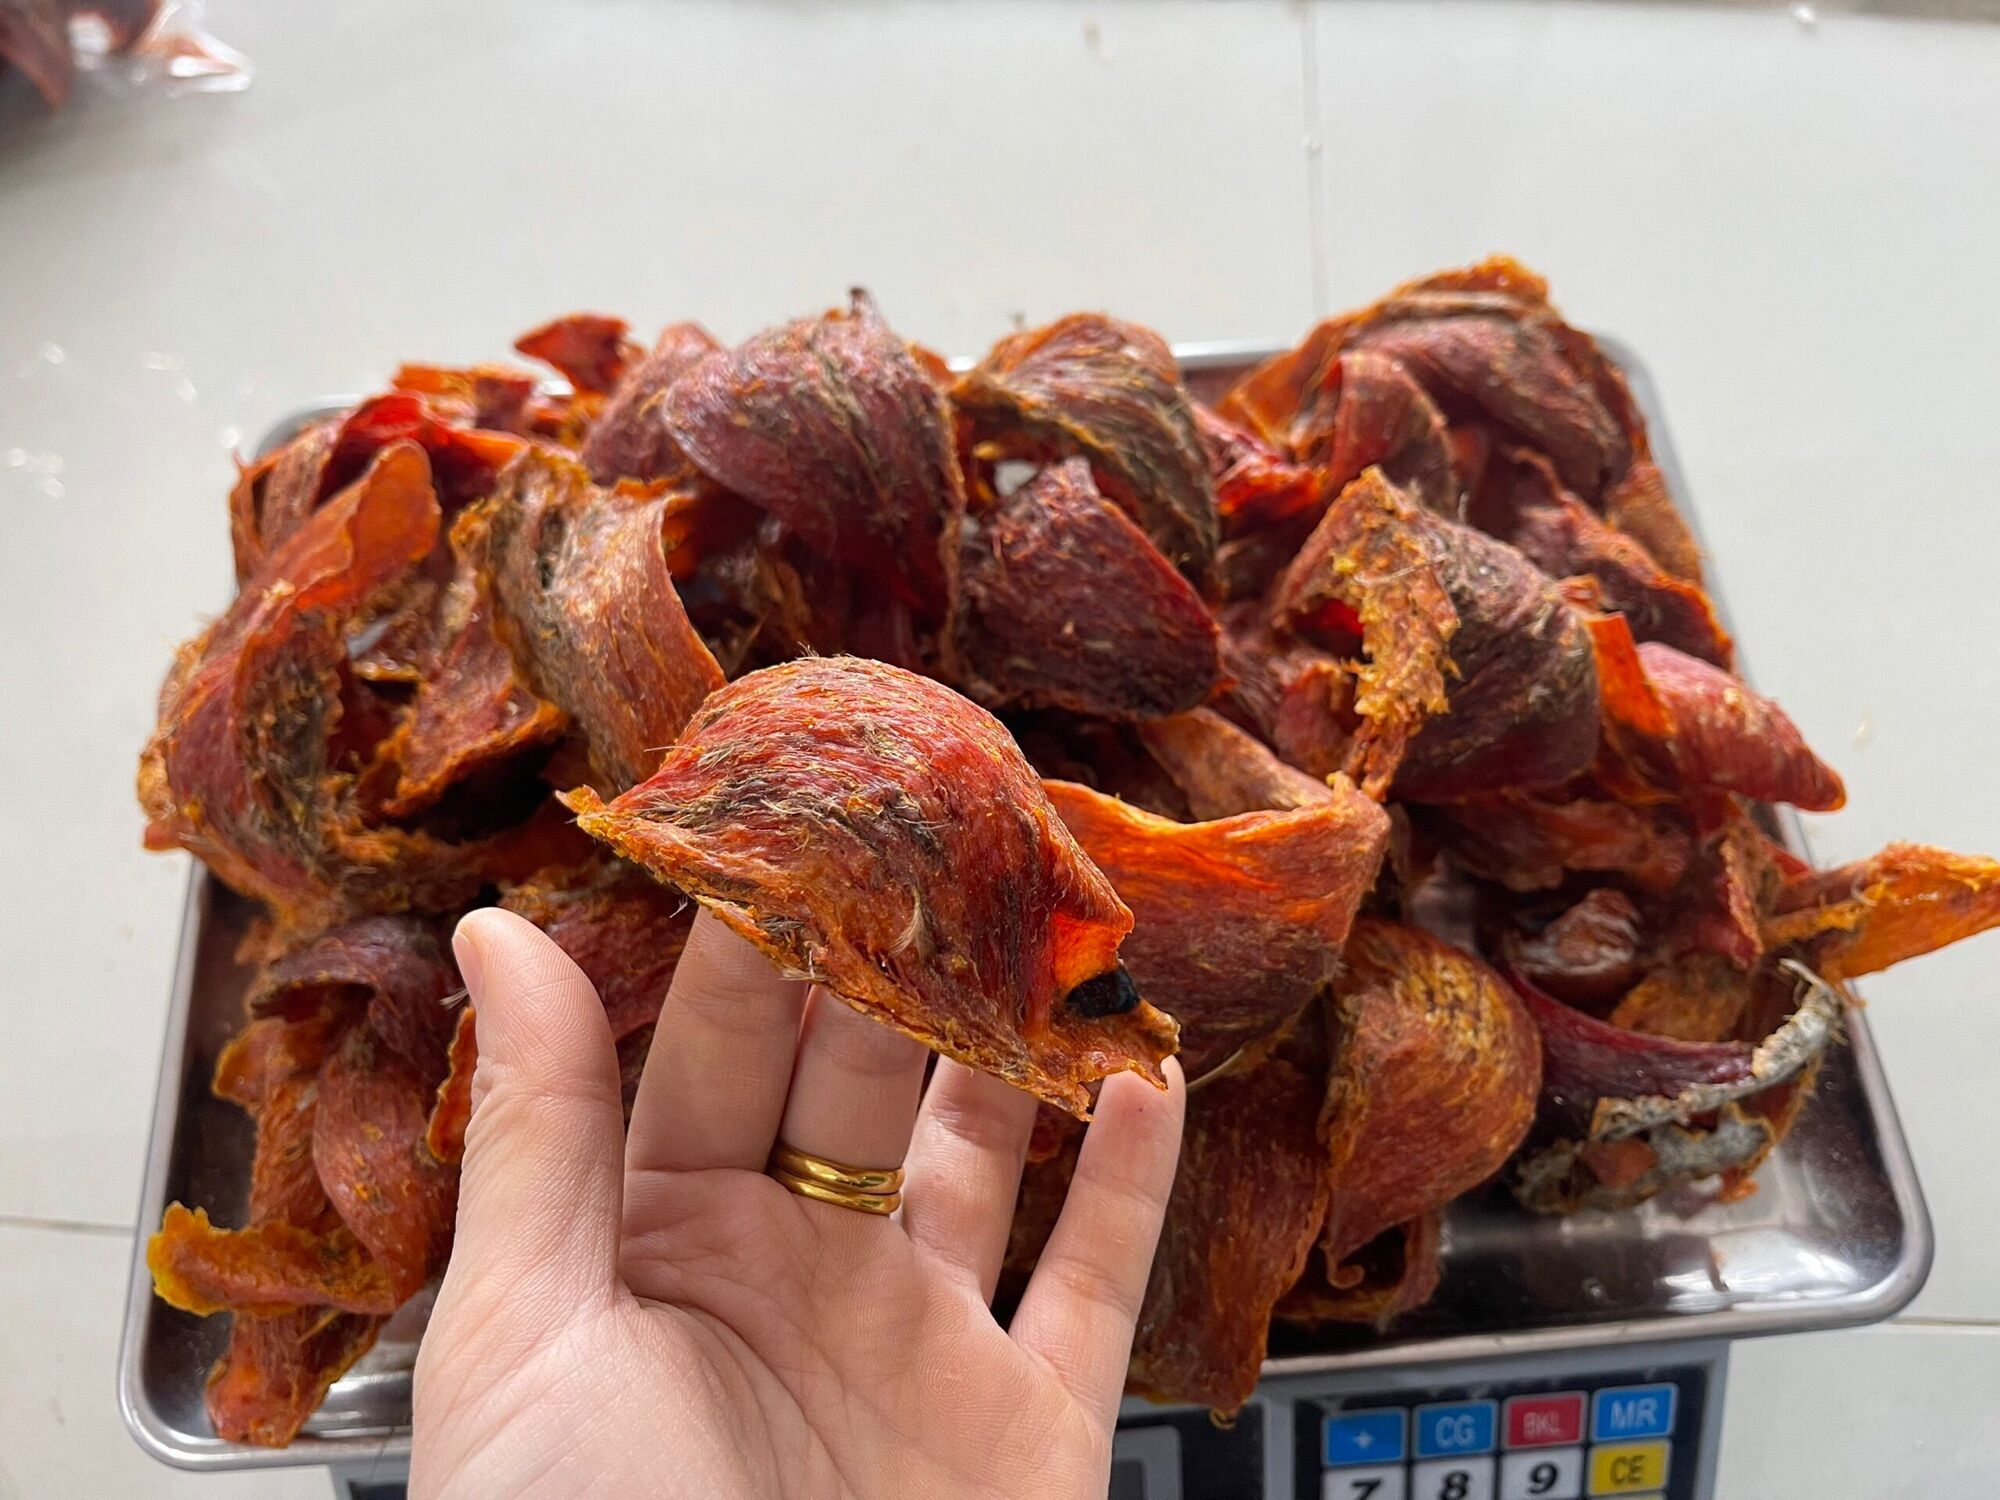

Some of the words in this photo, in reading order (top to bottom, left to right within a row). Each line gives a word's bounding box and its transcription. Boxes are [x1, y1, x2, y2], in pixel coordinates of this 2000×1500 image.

[1523, 1410, 1561, 1439] BKL
[1610, 1397, 1659, 1431] MR
[1435, 1414, 1476, 1449] CG
[1440, 1471, 1470, 1500] 8
[1527, 1460, 1559, 1495] 9
[1609, 1454, 1646, 1486] CE
[1351, 1478, 1382, 1500] 7
